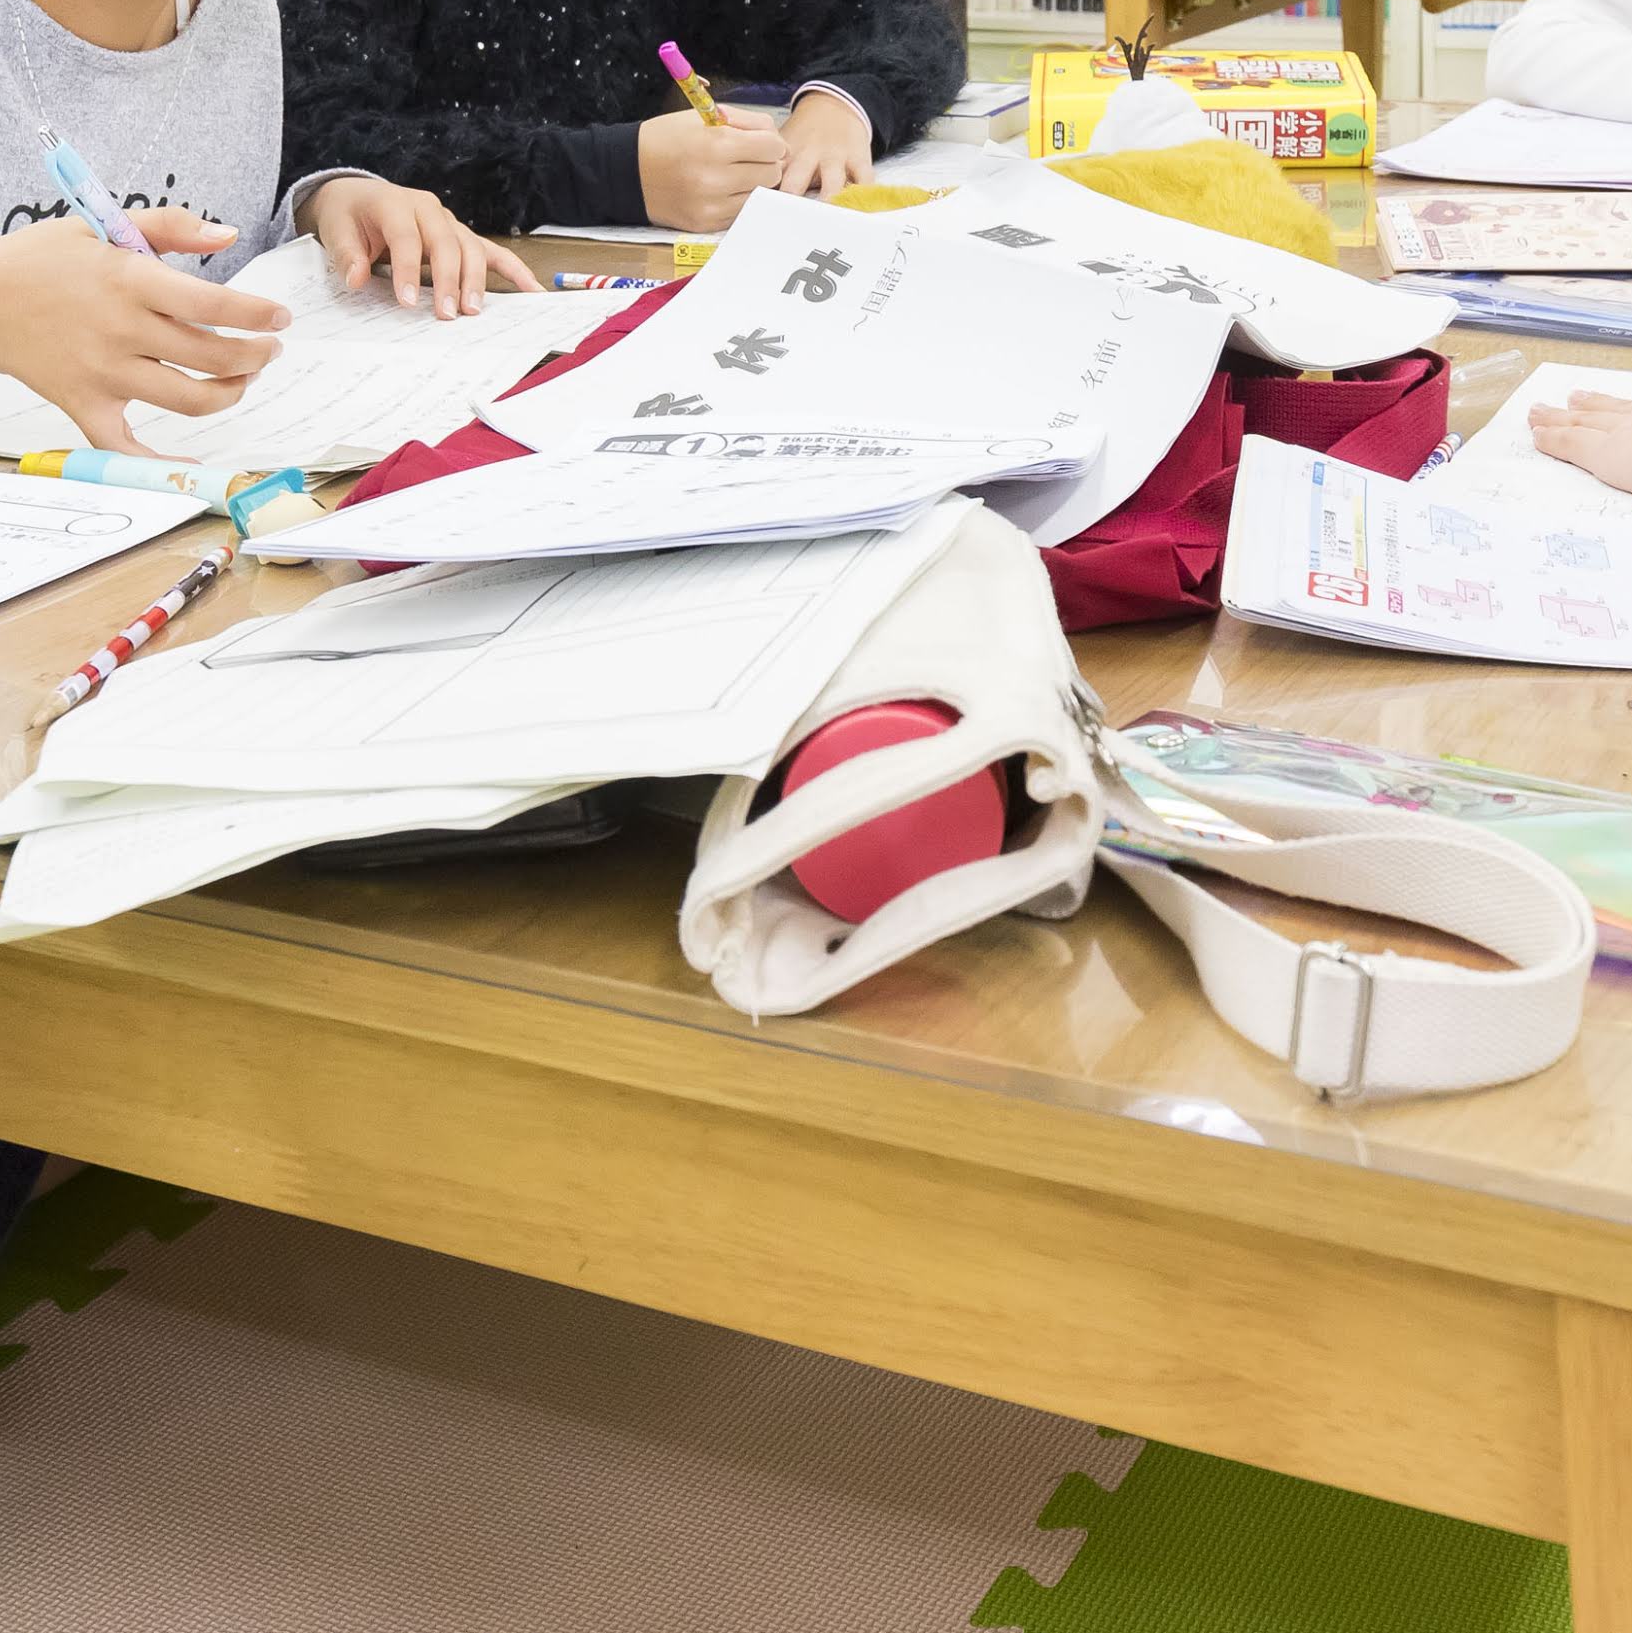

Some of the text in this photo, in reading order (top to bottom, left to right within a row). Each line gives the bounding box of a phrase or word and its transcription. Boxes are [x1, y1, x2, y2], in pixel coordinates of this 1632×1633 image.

[1329, 128, 1366, 141] 三省堂
[1598, 327, 1622, 336] ONE
[686, 437, 707, 455] 1
[773, 443, 915, 457] 漢字を読む
[1312, 573, 1366, 606] 26
